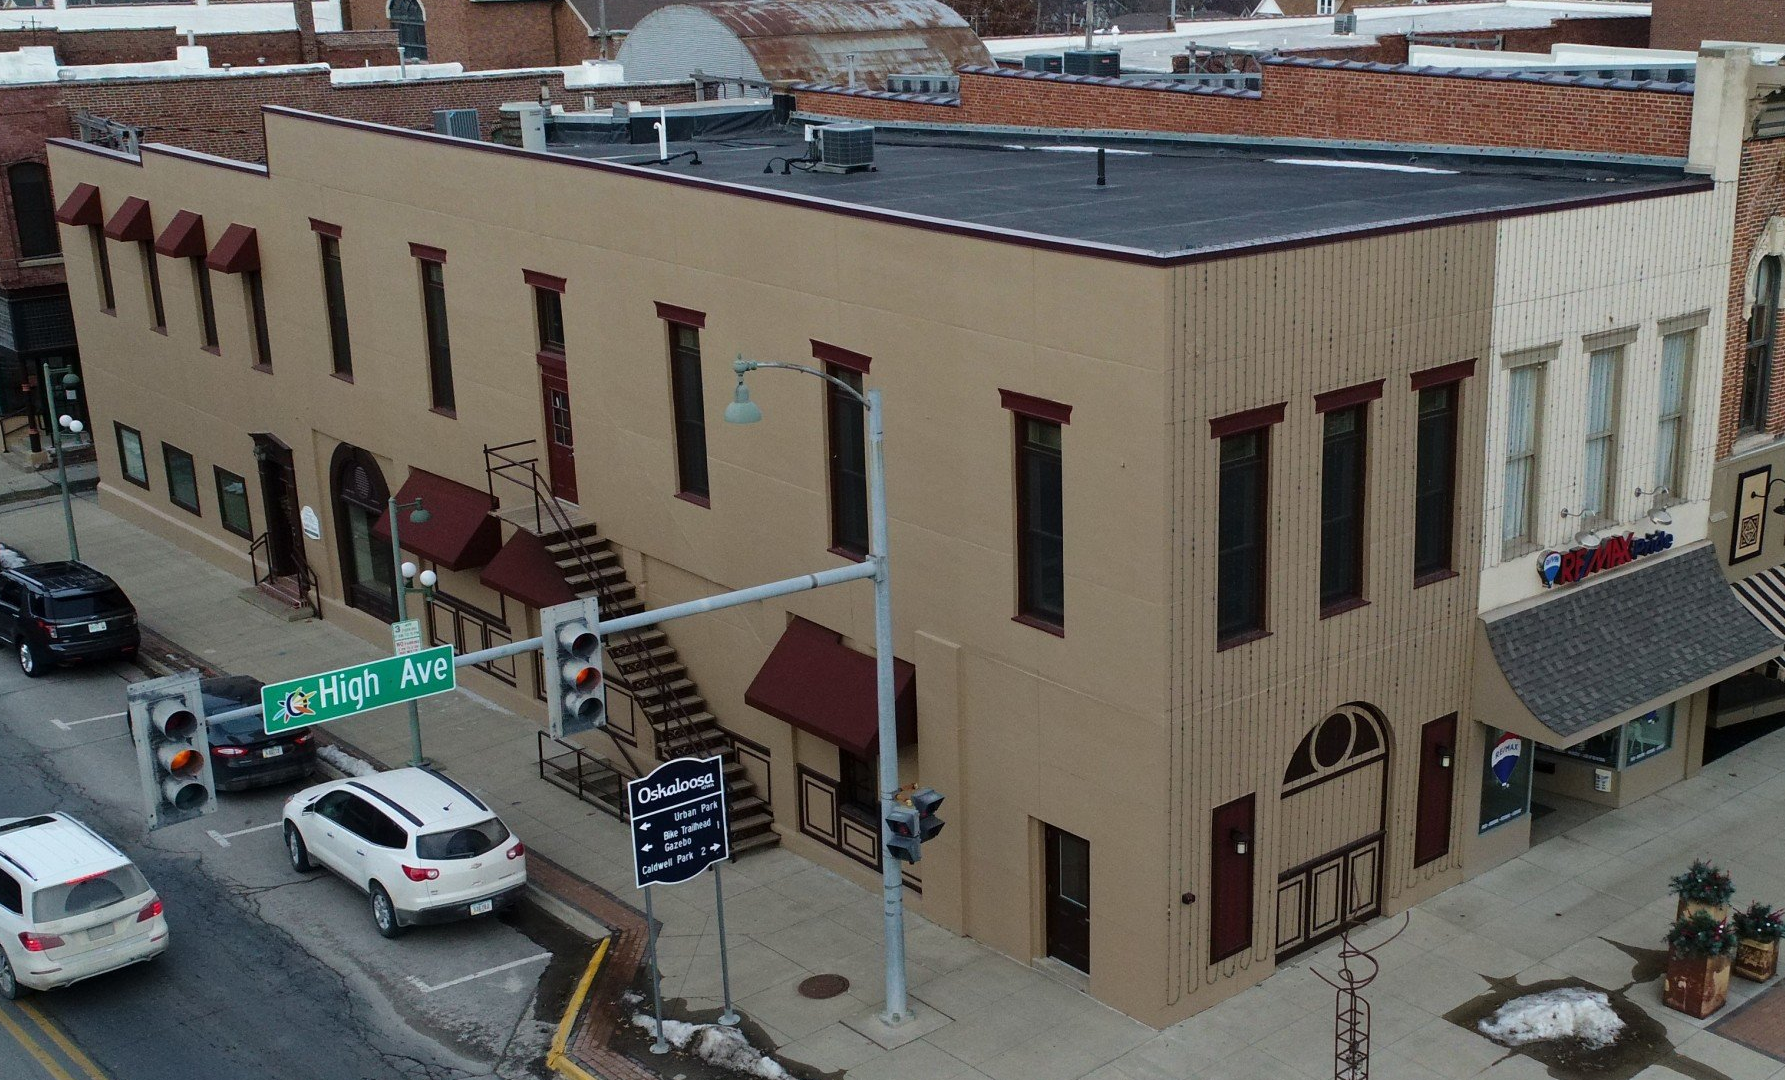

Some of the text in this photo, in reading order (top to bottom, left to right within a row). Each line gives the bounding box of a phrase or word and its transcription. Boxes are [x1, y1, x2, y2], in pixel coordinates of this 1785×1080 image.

[1560, 532, 1635, 585] RE/MAX
[318, 657, 448, 710] High Ave
[1494, 743, 1519, 759] RE/MAX
[637, 772, 715, 804] Oskaloosa
[674, 801, 718, 821] Urban Park
[663, 829, 679, 840] Bike
[680, 818, 712, 835] Trailhead
[664, 838, 692, 852] Gazebo
[642, 846, 707, 875] Caldwell Park 2
